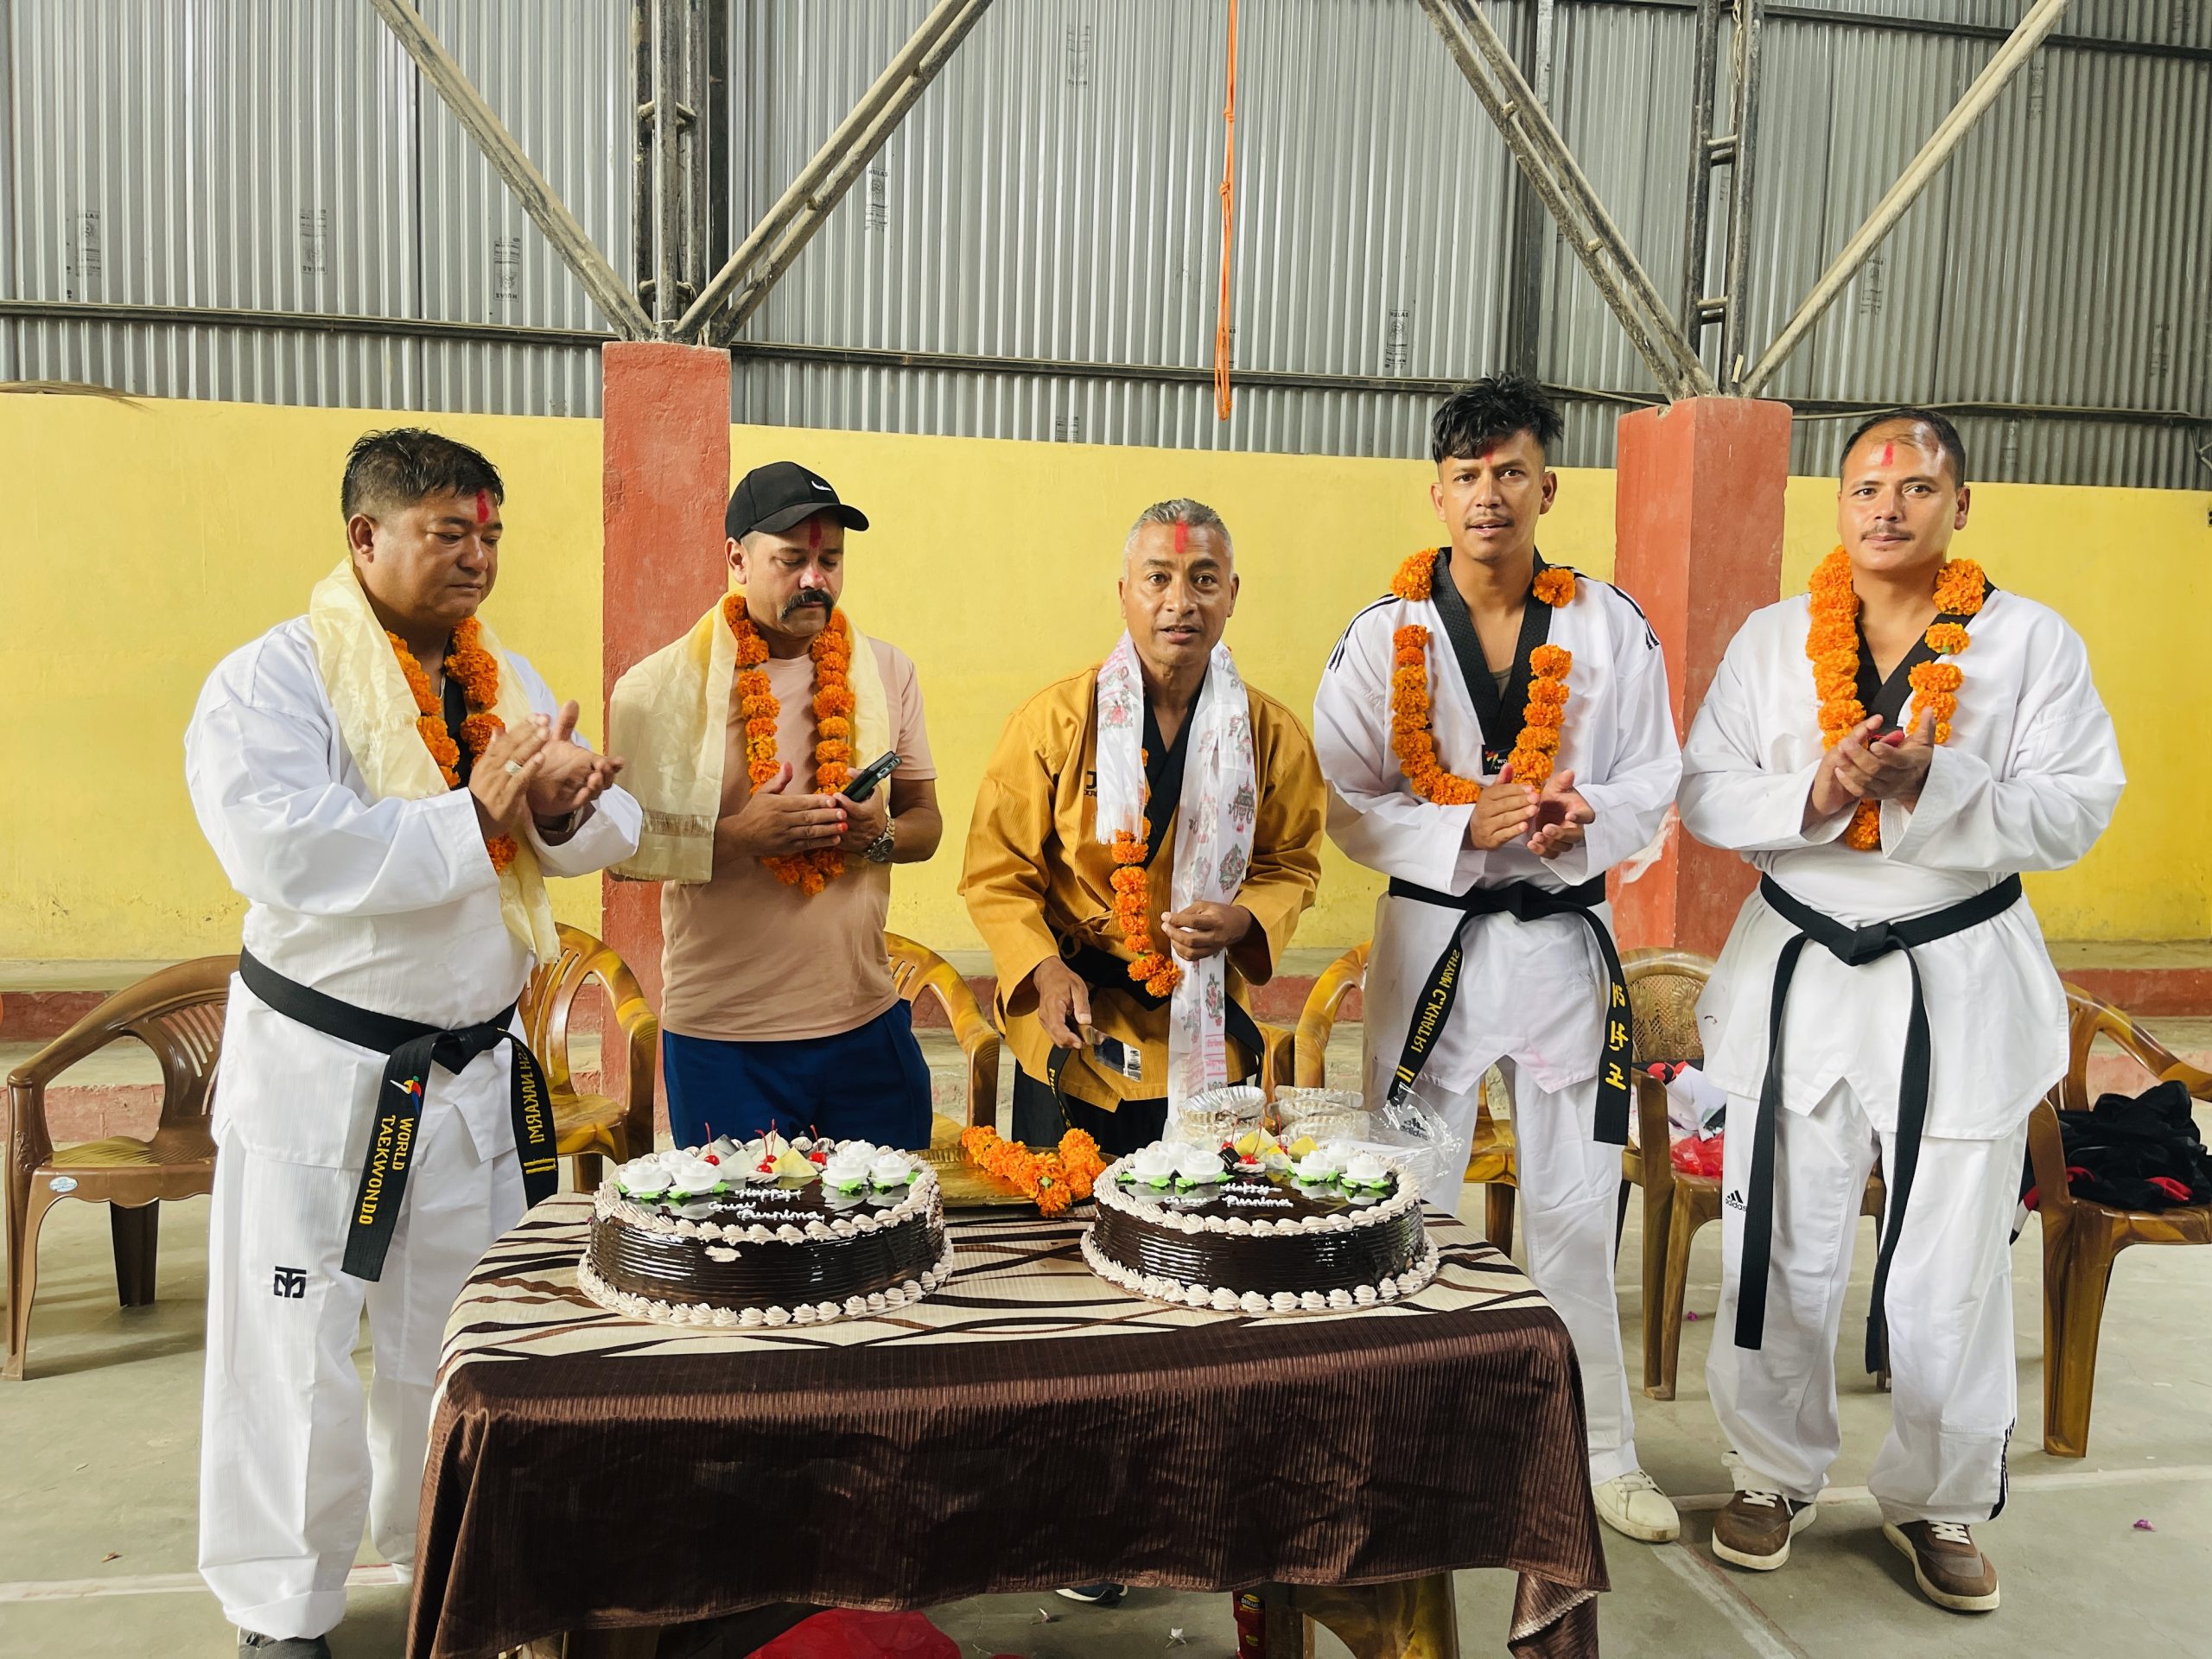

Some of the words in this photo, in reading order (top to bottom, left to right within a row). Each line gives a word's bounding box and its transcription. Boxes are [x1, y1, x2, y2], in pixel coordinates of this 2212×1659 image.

[391, 1116, 415, 1172] WORLD
[359, 1114, 397, 1225] TAEKWONDO
[734, 1188, 804, 1202] Happy
[1219, 1181, 1282, 1195] Happy
[1222, 1194, 1294, 1208] Purnima
[708, 1200, 757, 1213] Guru
[737, 1208, 825, 1224] Purnima
